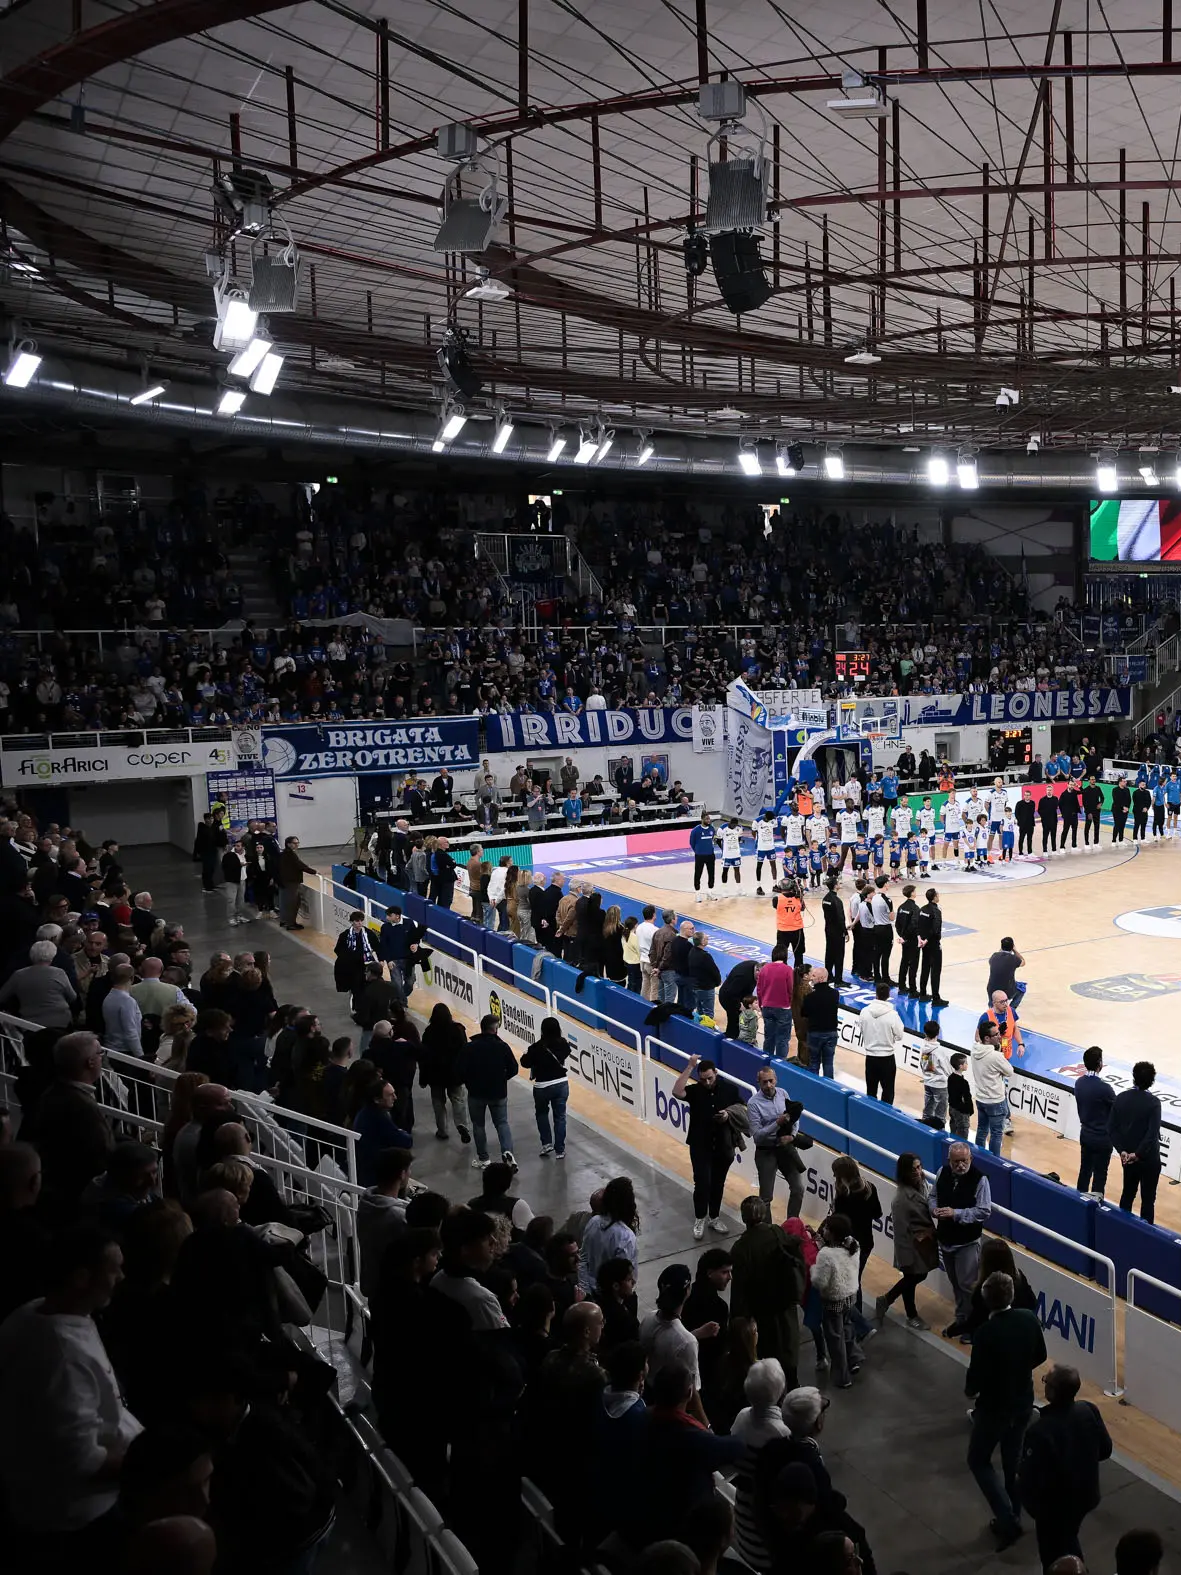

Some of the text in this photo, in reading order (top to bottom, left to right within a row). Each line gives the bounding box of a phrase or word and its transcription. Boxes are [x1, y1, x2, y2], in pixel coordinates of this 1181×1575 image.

[849, 662, 869, 676] 24
[756, 689, 820, 704] ASFERTE
[972, 688, 1122, 721] LEONESSA
[328, 727, 443, 748] BRIGATA
[701, 737, 715, 746] VIVE
[298, 744, 472, 770] ZEROTRENTA
[297, 784, 306, 793] 13
[434, 964, 474, 1005] mazza
[501, 999, 535, 1030] Gandellini
[591, 1043, 633, 1071] METROLOGIA
[568, 1040, 634, 1106] ECHNE
[1006, 1086, 1060, 1124] CHNE
[1022, 1082, 1060, 1101] METROLOGIA
[1035, 1291, 1096, 1354] MANI
